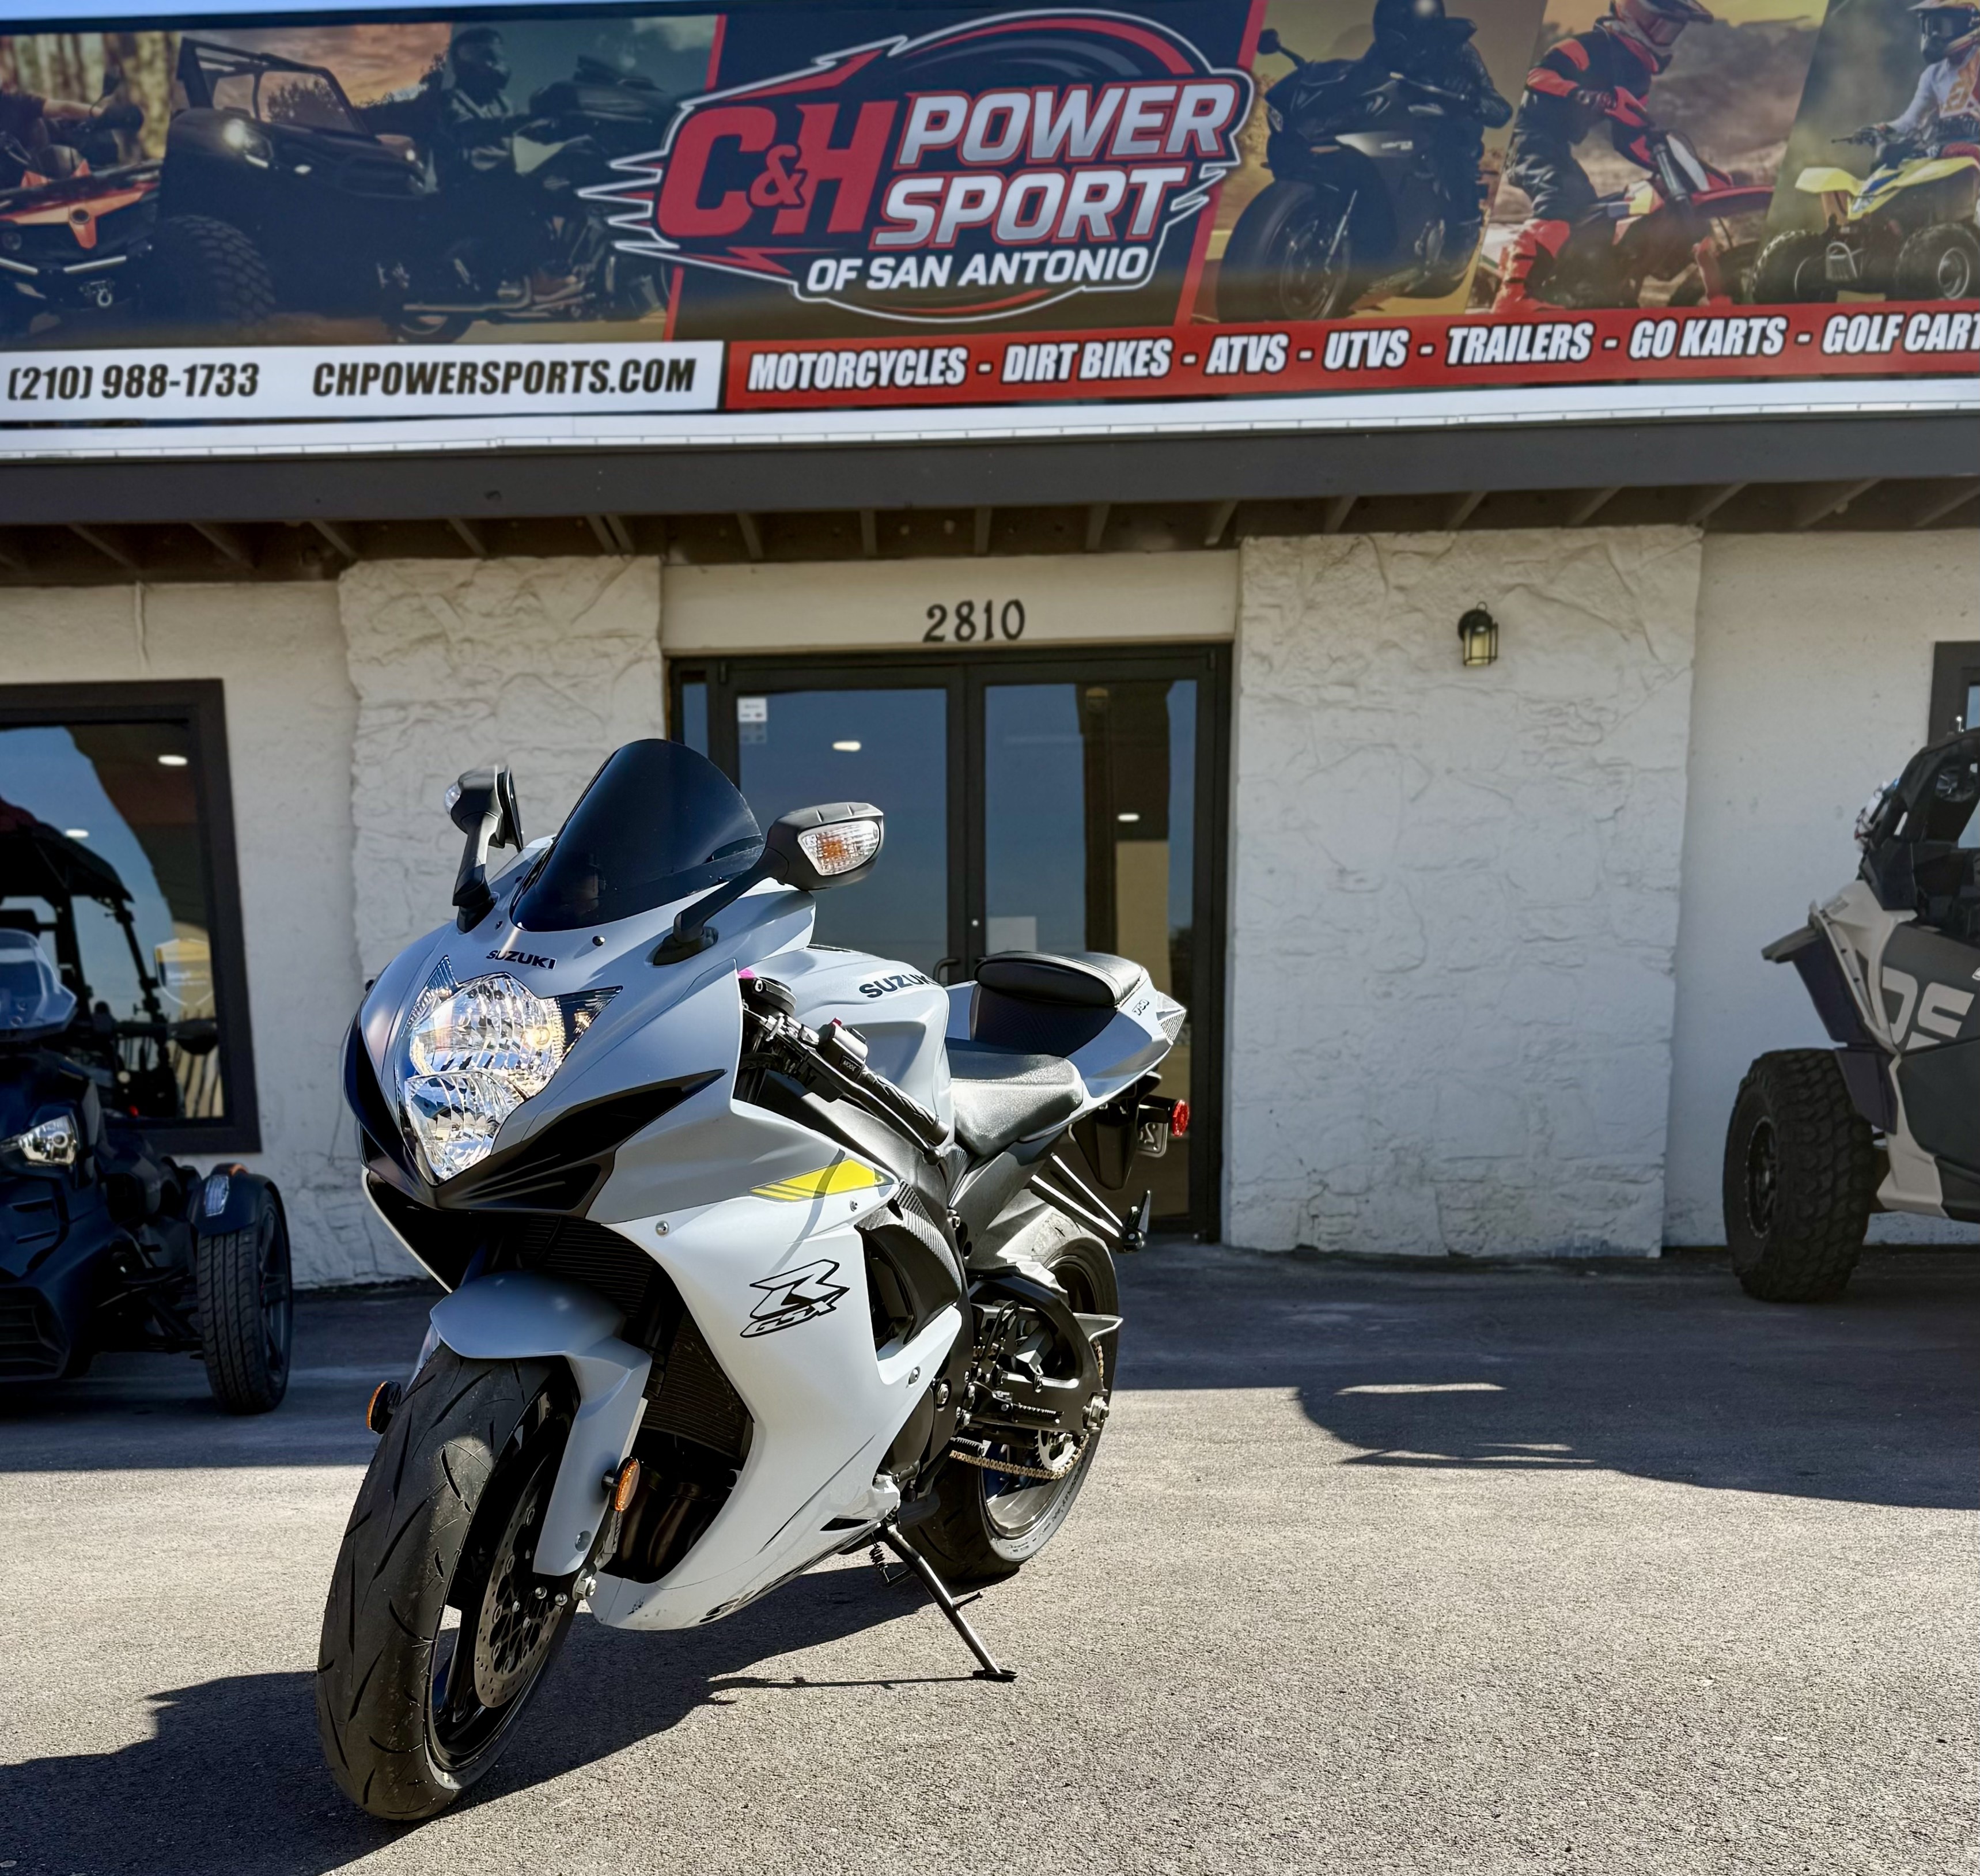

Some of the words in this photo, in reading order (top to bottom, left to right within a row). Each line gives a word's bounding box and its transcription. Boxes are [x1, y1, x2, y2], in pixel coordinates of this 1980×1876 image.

[898, 81, 1237, 167] POWER
[658, 100, 899, 237] C&H
[870, 164, 1189, 248] SPORT
[807, 258, 860, 293] OF
[865, 254, 954, 289] SAN
[956, 245, 1149, 286] ANTONIO
[748, 347, 968, 391] MOTORCYCLES
[1001, 343, 1078, 382] DIRT
[1078, 338, 1173, 380] BIKES
[1206, 334, 1289, 374] ATVS
[1324, 328, 1410, 369] UTVS
[1446, 323, 1594, 365] TRAILERS
[1629, 320, 1678, 358] GO
[1679, 316, 1786, 357] KARTS
[1822, 313, 1904, 353] GOLF
[1904, 312, 1980, 351] CART
[8, 365, 93, 401] (210)
[101, 364, 260, 400] 988-1733
[312, 358, 696, 397] CHPOWERSPORTS.COM
[923, 599, 1025, 642] 2810
[486, 950, 556, 970] SUZUKI
